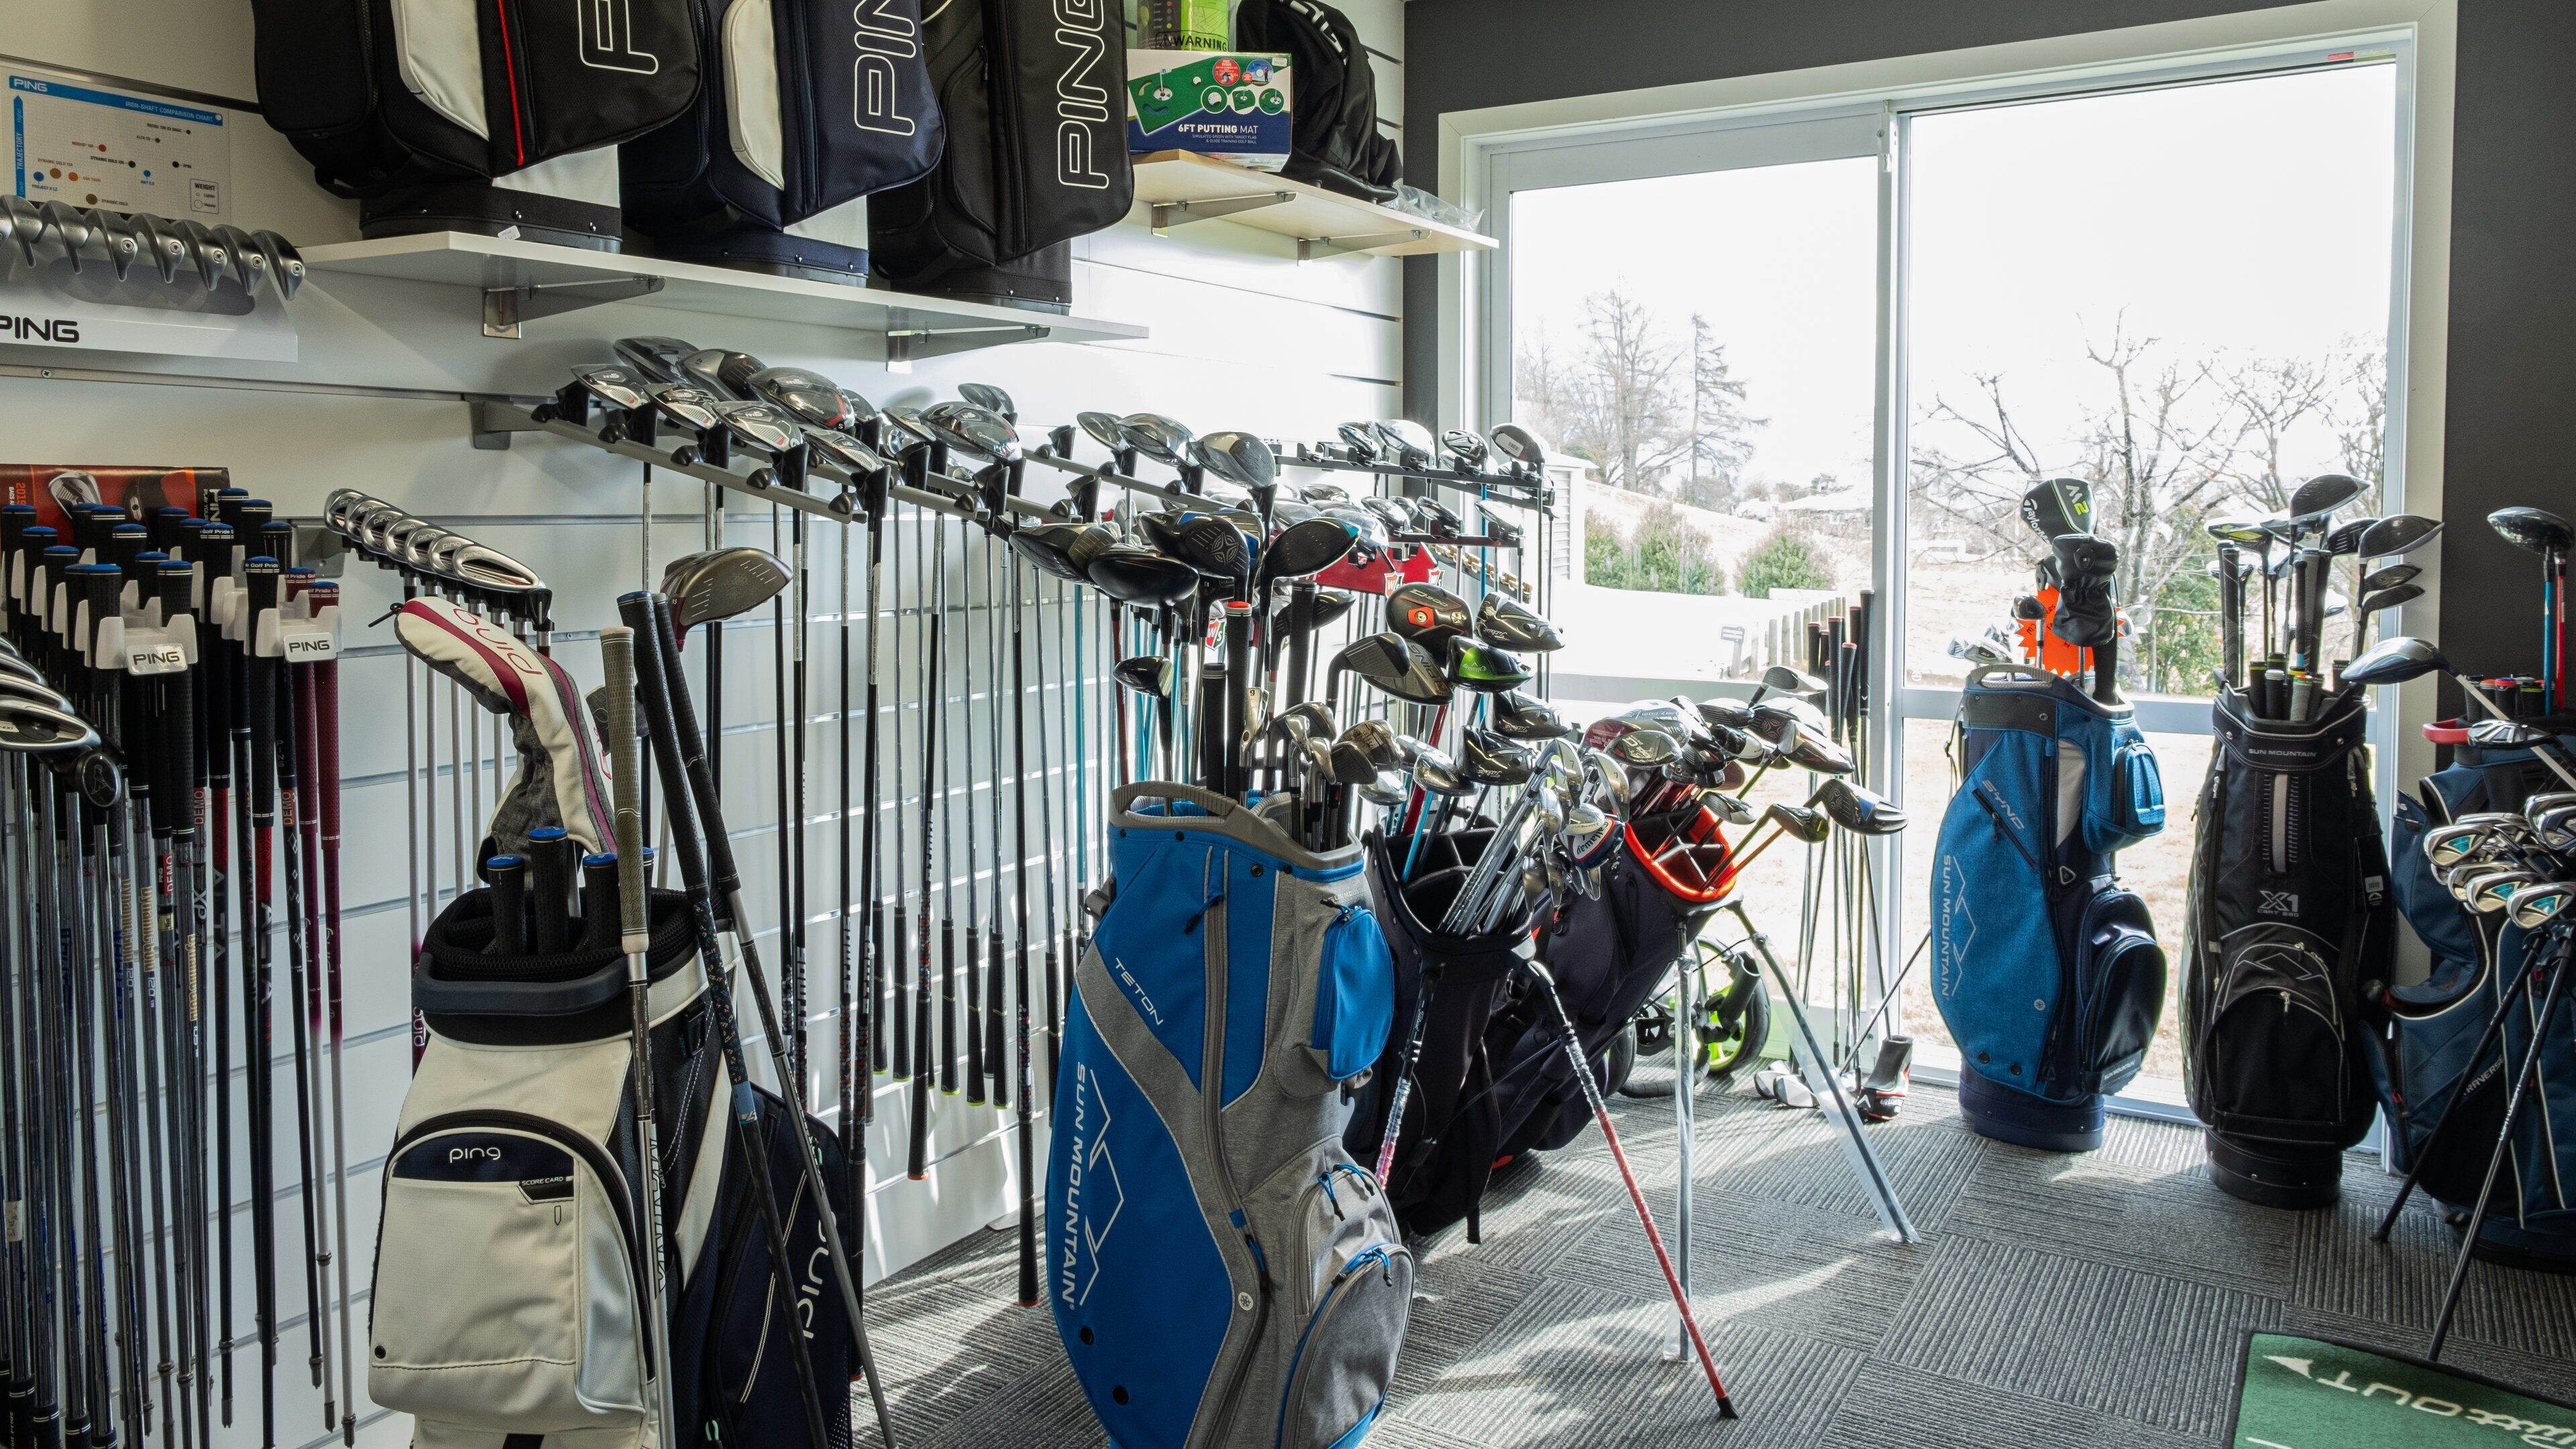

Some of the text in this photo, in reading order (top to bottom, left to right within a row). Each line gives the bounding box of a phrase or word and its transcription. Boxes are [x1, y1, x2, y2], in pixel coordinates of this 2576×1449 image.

[1174, 34, 1228, 52] WARNING
[14, 78, 48, 92] PING
[1053, 0, 1110, 191] PING
[125, 101, 213, 122] IRON-SHAFT COMPARISON CHART
[1178, 124, 1258, 134] 6FT PUTTING MAT
[194, 182, 215, 191] WEIGHT
[2066, 485, 2089, 515] M2
[2023, 498, 2049, 545] TaylorMa
[418, 532, 436, 541] ping
[442, 541, 461, 549] ping
[464, 551, 482, 559] ping
[288, 639, 329, 653] PING
[452, 607, 542, 676] ping
[133, 650, 180, 665] PING
[2267, 749, 2316, 758] MOUNTAIN
[194, 791, 205, 824] DEMO
[282, 792, 292, 826] DEMO
[1982, 780, 2025, 830] SYNC
[2259, 890, 2298, 912] X1
[139, 886, 153, 942] Dynamic
[1941, 855, 1952, 996] SUN MOUNTAIN
[143, 943, 154, 973] Gold
[1115, 957, 1165, 1027] TETON
[2464, 1055, 2505, 1095] RAVERSE
[449, 1146, 500, 1164] ping
[521, 1176, 564, 1186] SCORE CARD
[1061, 1062, 1085, 1301] SUN MOUNTAIN
